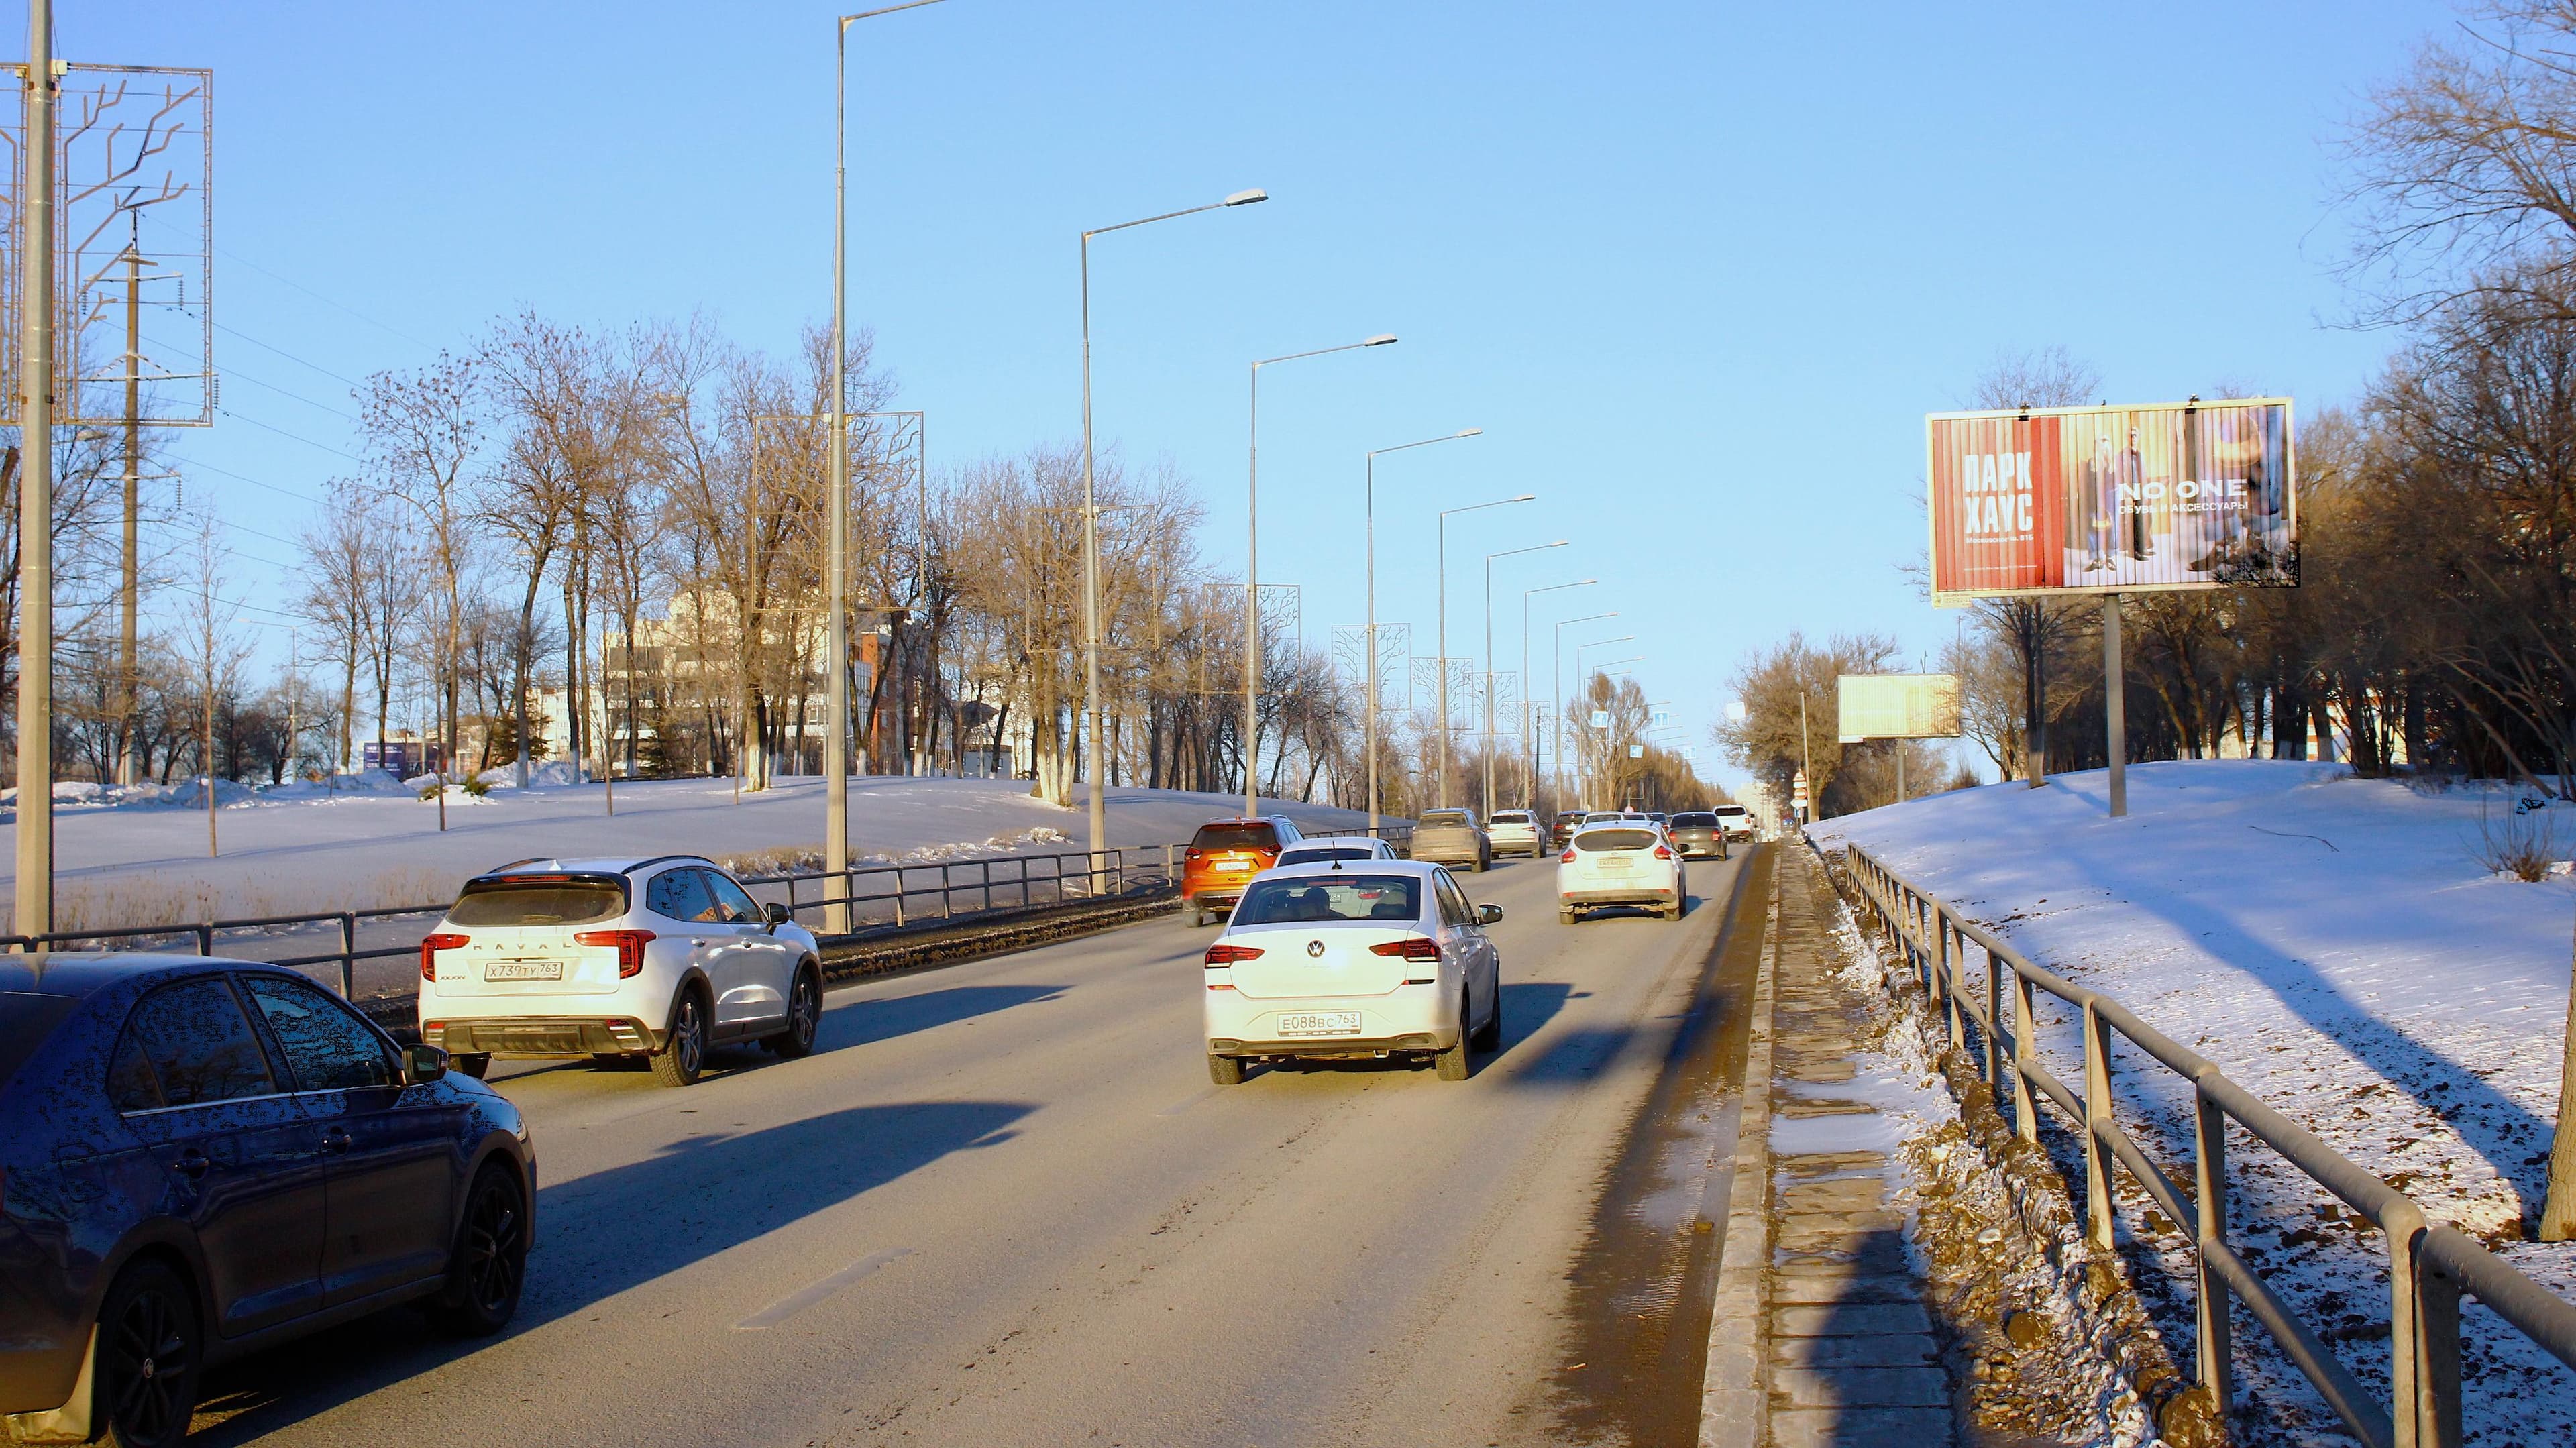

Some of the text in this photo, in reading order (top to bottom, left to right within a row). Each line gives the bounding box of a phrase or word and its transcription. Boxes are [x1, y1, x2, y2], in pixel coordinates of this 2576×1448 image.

[1964, 451, 2033, 492] ПАРК
[2118, 478, 2247, 501] NO ONE
[1964, 493, 2033, 534] ХАУС
[2119, 501, 2249, 515] ОБУВЬ И АКСЕССУАРЫ
[539, 964, 558, 973] 763
[1283, 1014, 1356, 1029] Е088ВС 763
